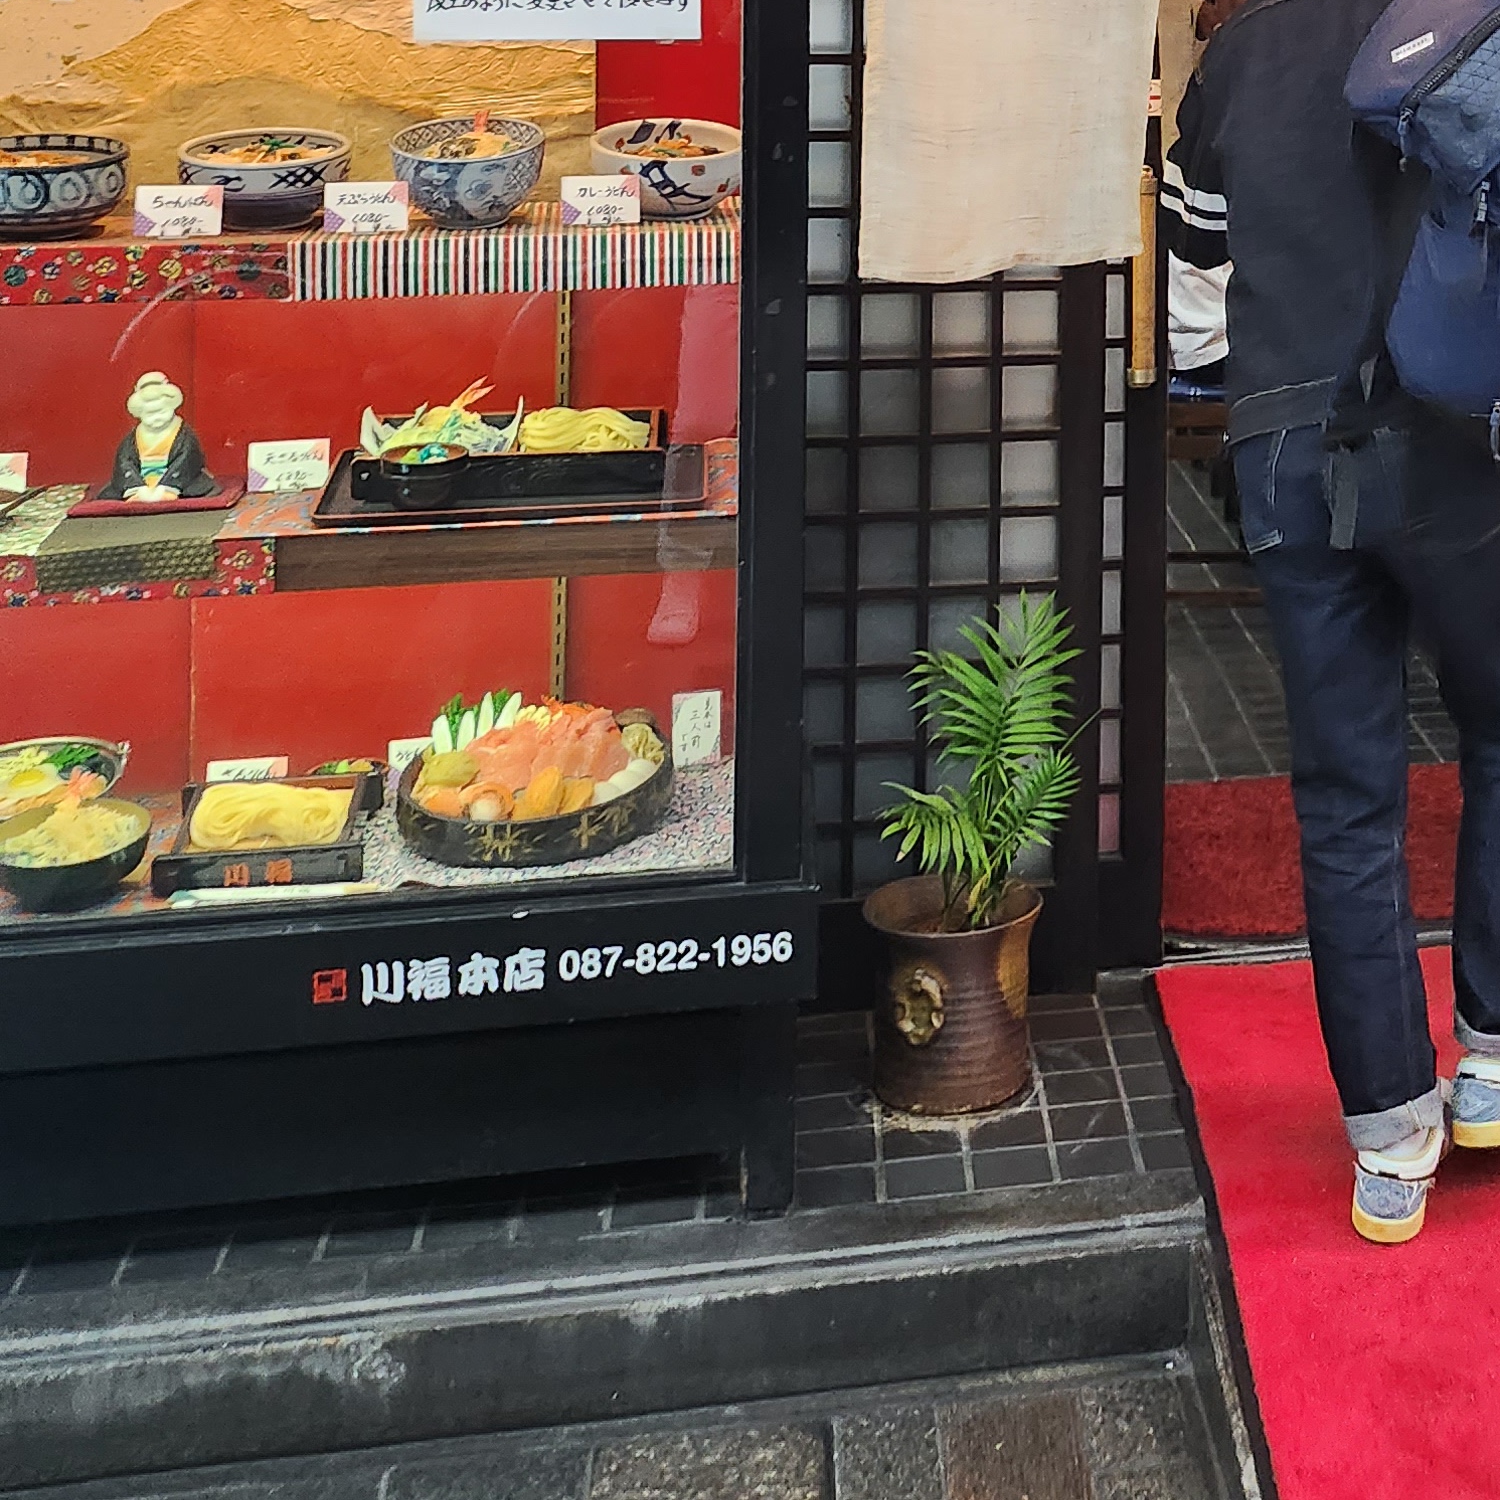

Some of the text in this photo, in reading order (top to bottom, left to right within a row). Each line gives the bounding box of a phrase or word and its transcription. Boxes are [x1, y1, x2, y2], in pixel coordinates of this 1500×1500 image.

[336, 191, 397, 206] 天ぷらうどん
[576, 185, 635, 198] カレーうどん
[360, 948, 547, 1005] 川福本店
[558, 931, 794, 982] 087-822-1956
